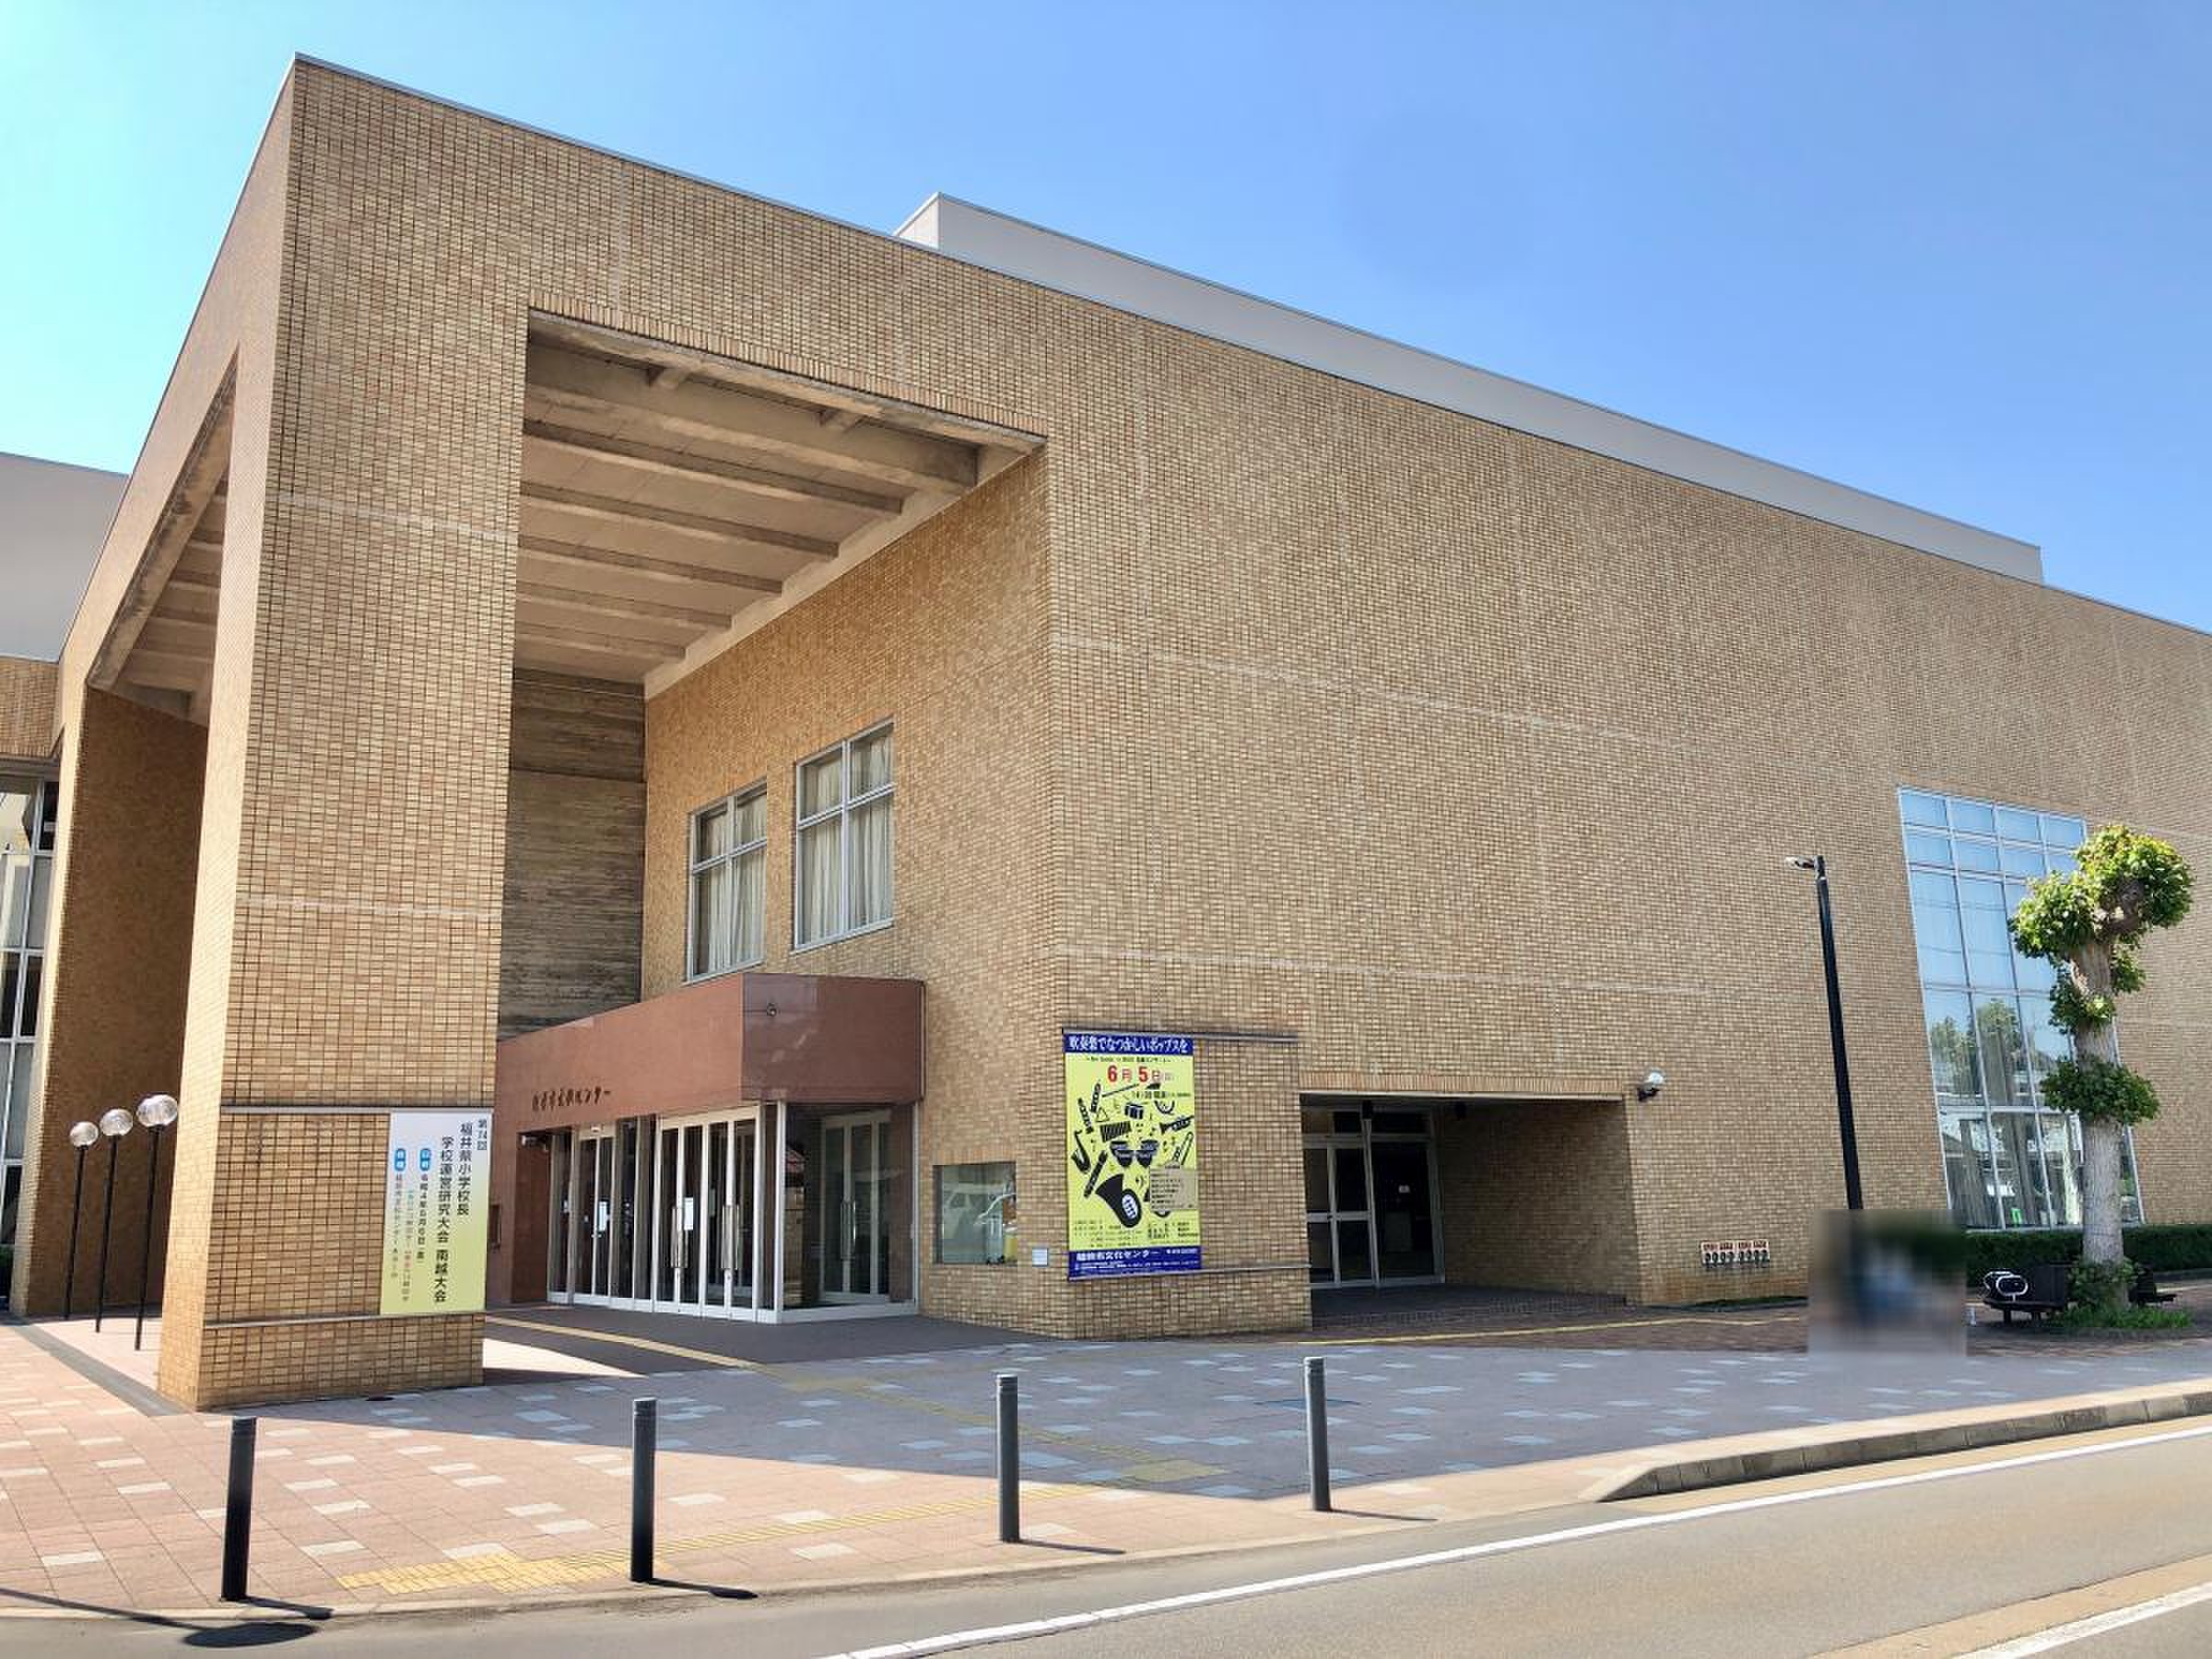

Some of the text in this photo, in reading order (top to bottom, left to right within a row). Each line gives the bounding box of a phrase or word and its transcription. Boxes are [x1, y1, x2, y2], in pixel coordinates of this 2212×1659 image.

[456, 1122, 473, 1216] 福井県小学校長
